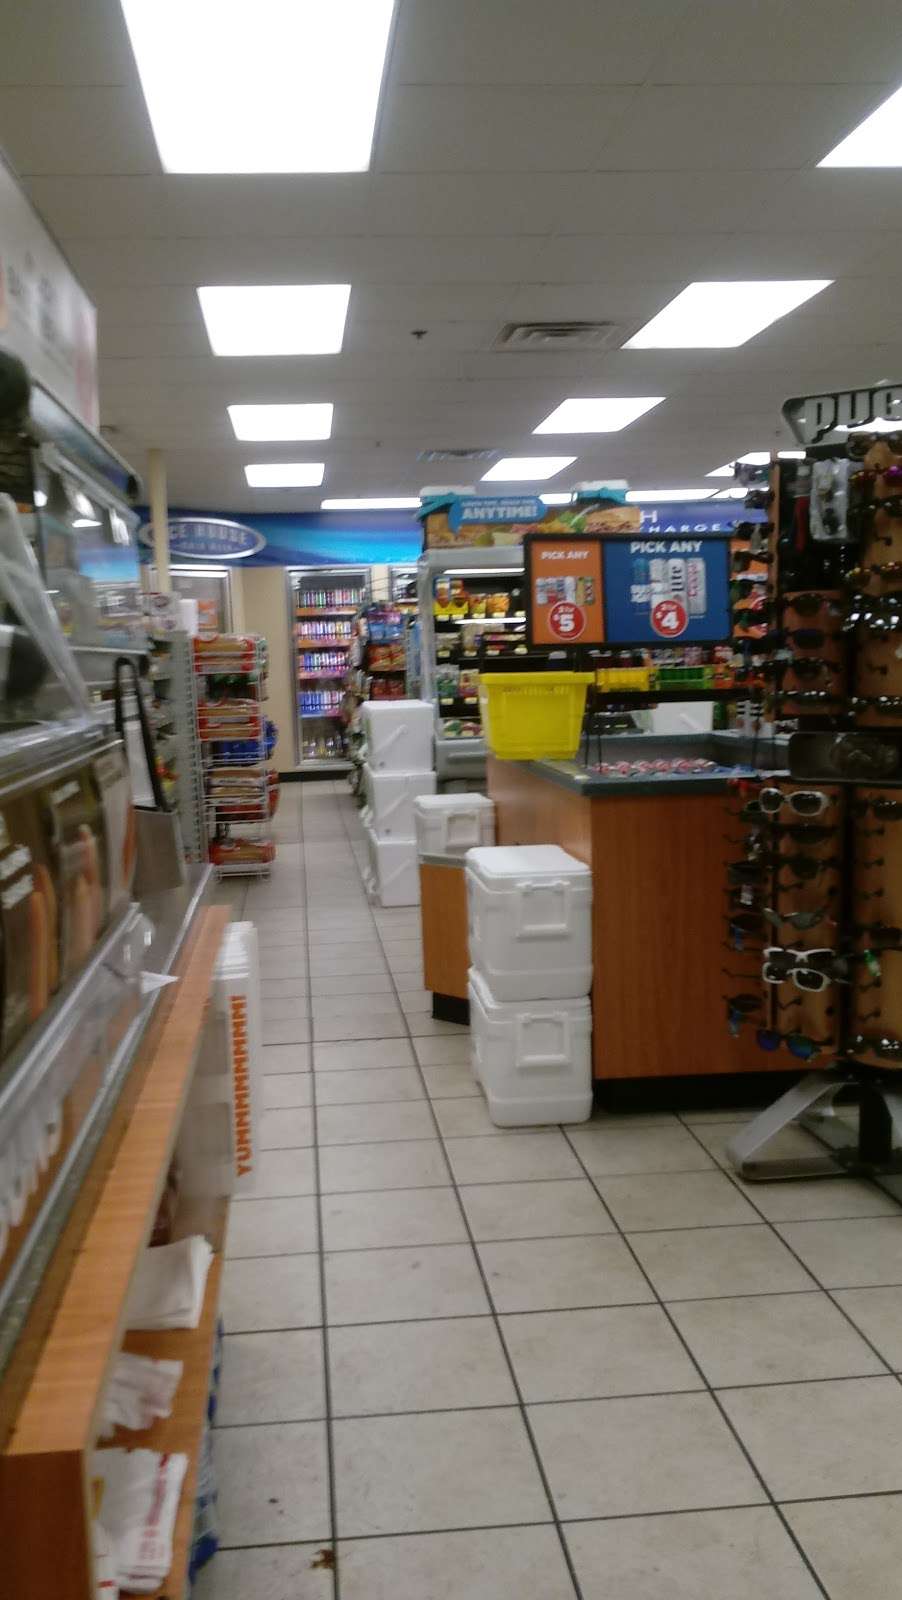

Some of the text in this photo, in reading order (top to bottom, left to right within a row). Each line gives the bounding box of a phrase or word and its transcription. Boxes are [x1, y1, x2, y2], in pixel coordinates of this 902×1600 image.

[462, 506, 538, 519] ANYTIME!
[640, 523, 721, 533] HARGE
[630, 541, 703, 553] PICK ANY
[541, 551, 589, 560] PICK ANY
